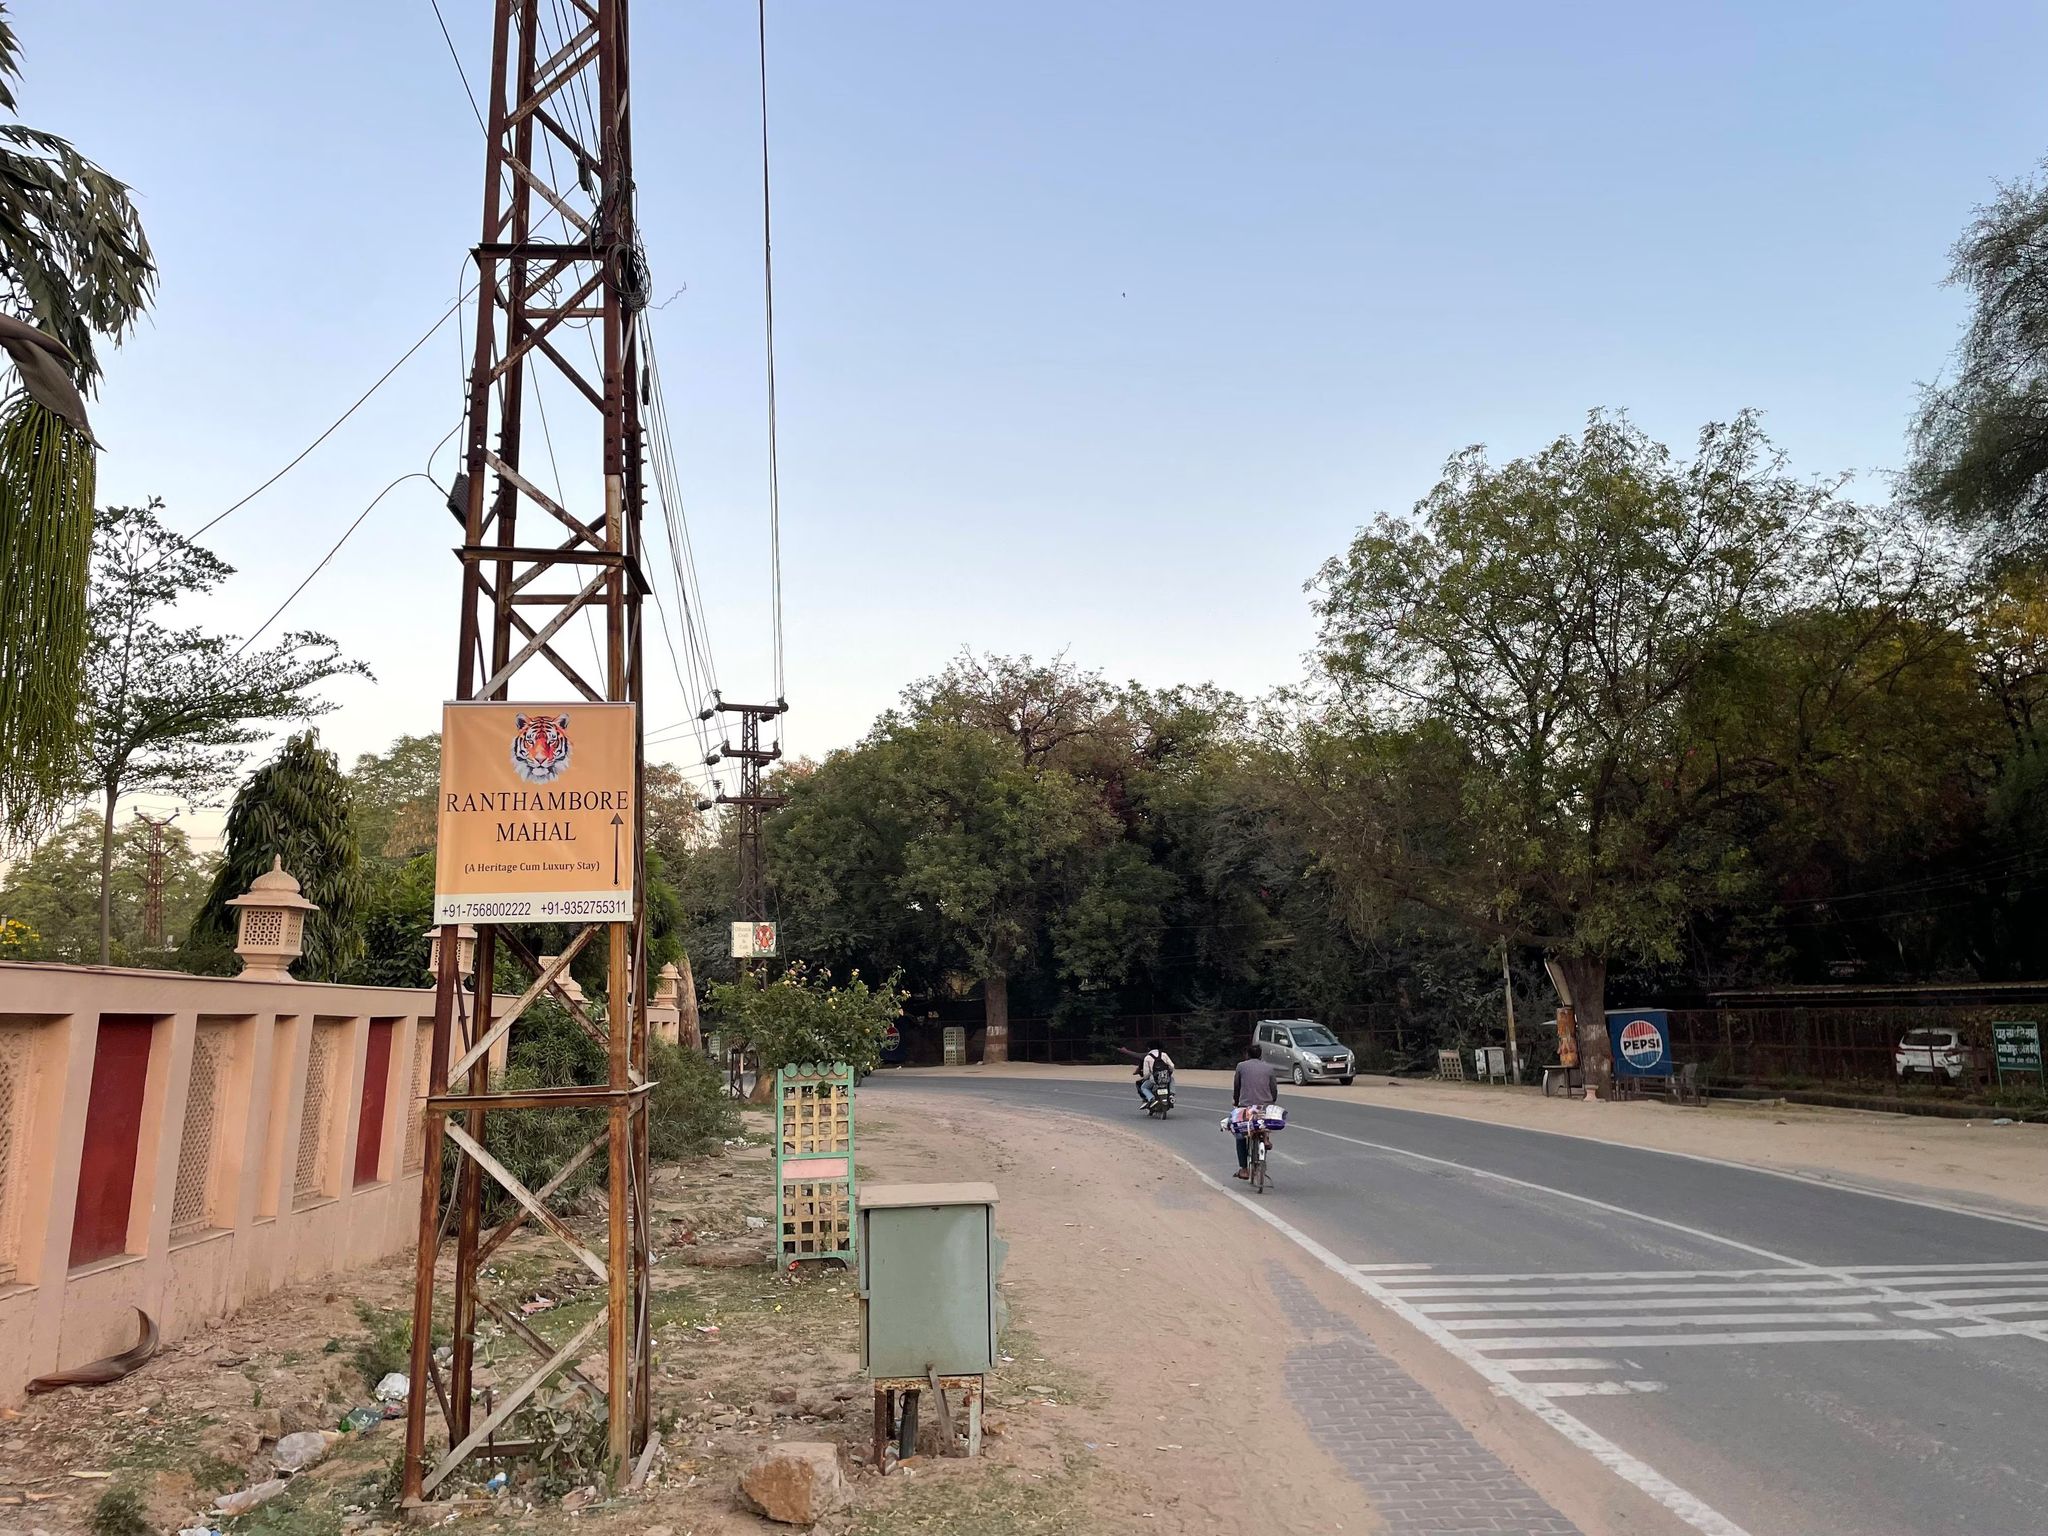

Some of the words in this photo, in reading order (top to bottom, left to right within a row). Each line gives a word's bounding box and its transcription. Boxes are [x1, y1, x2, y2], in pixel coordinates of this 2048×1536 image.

[446, 791, 629, 812] RANTHAMBORE
[496, 822, 577, 842] MAHAL
[465, 863, 475, 874] (A
[477, 863, 518, 874] Heritage
[520, 863, 540, 871] Cum
[542, 862, 575, 872] Luxury
[577, 861, 600, 872] Stay)
[442, 903, 531, 918] +91-7568002222
[541, 900, 626, 915] +91-9352755311
[1623, 1039, 1660, 1050] PEPSI
